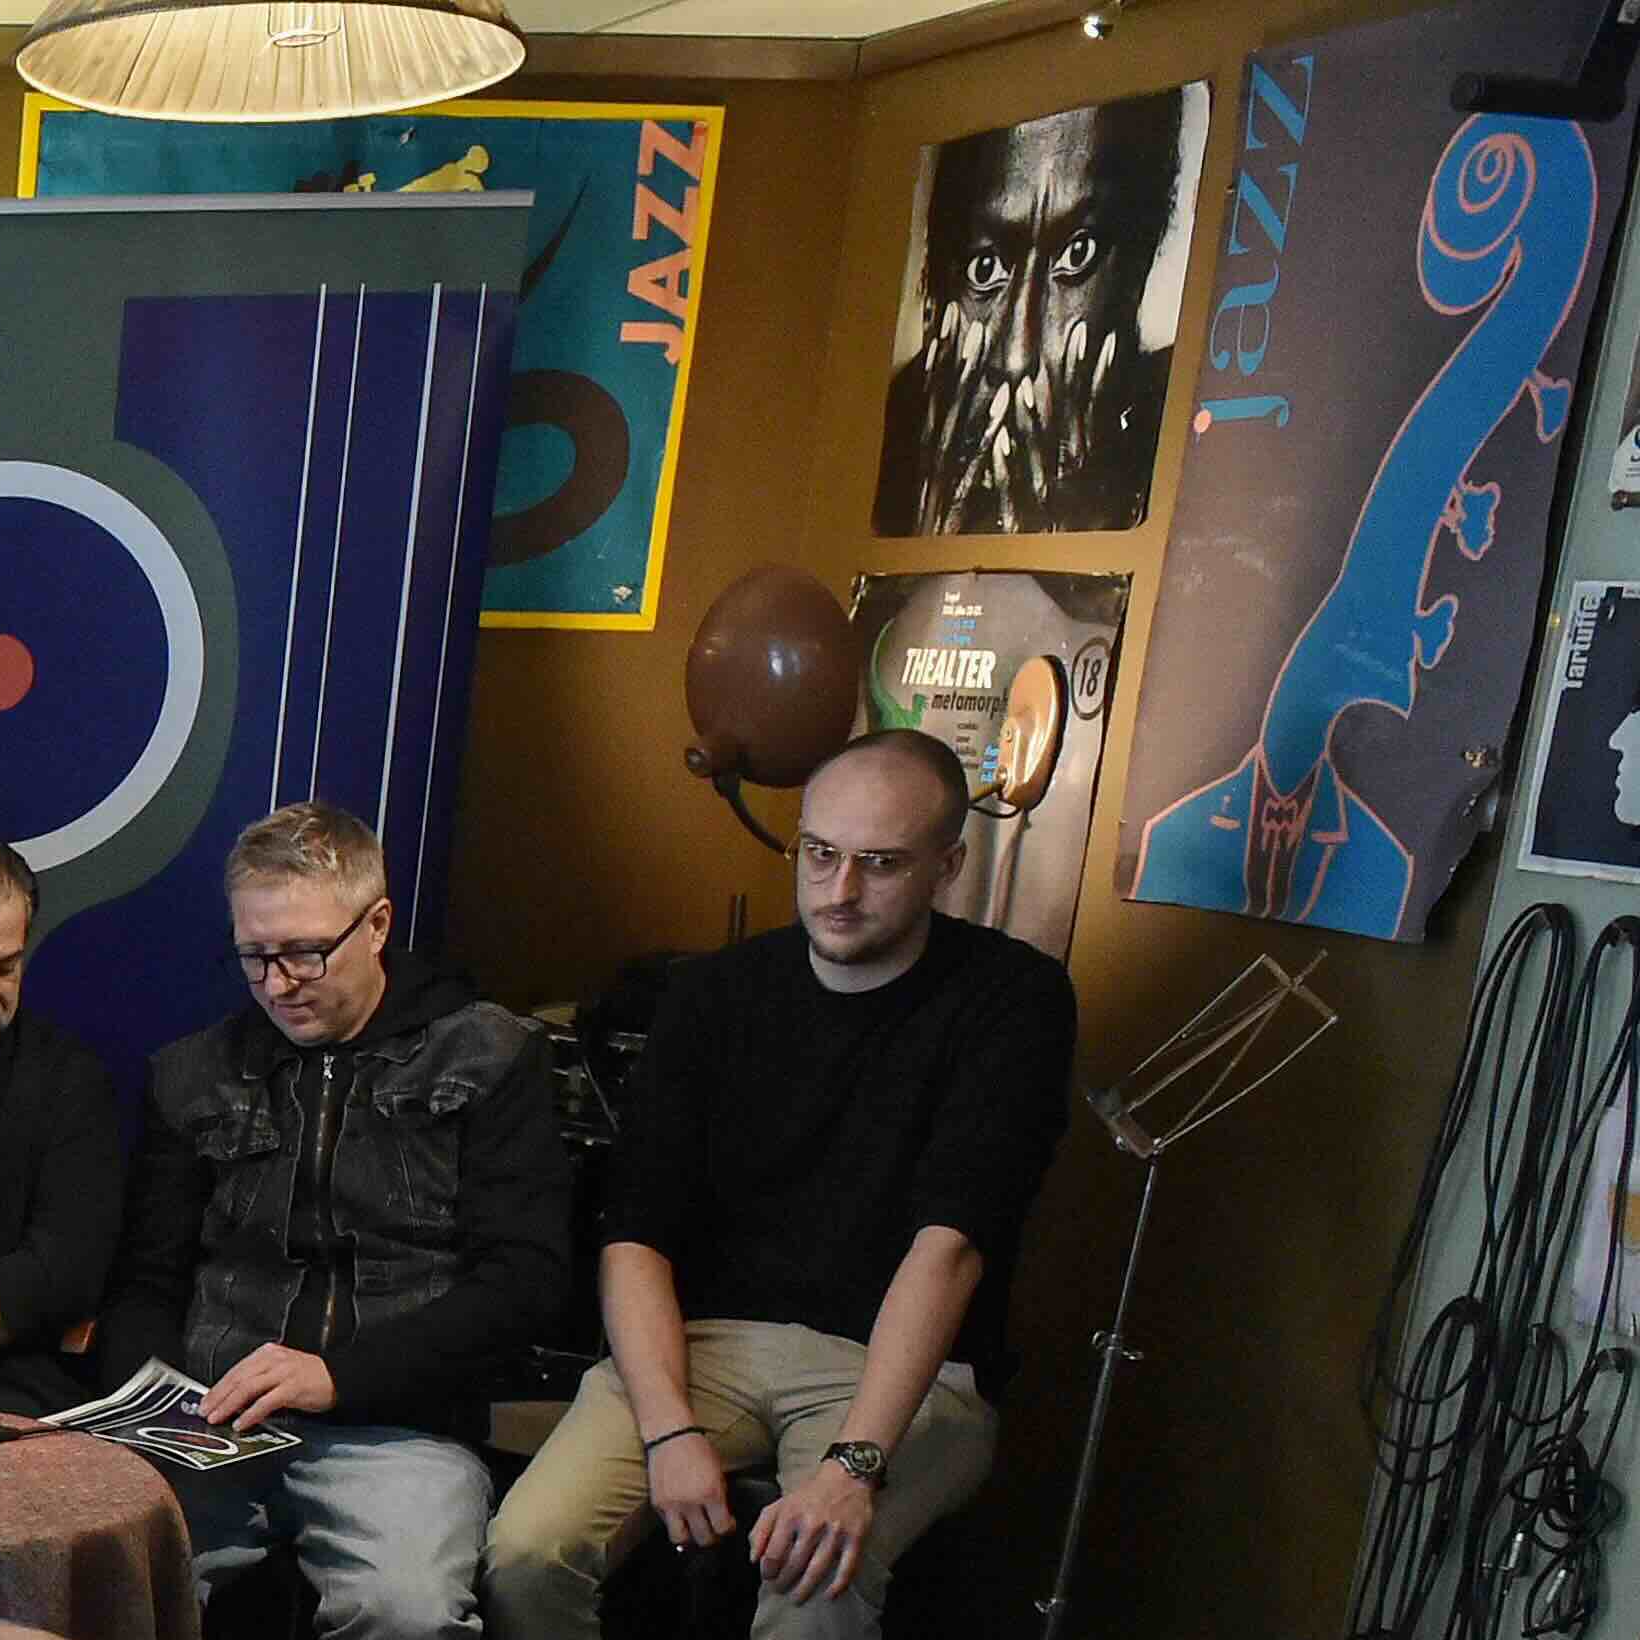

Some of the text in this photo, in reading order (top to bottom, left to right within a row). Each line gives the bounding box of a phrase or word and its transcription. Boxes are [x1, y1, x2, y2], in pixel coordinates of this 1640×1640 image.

[620, 119, 708, 365] JAZZ
[1193, 52, 1316, 446] jazz
[901, 647, 997, 689] THEALTER
[1079, 658, 1102, 698] 18
